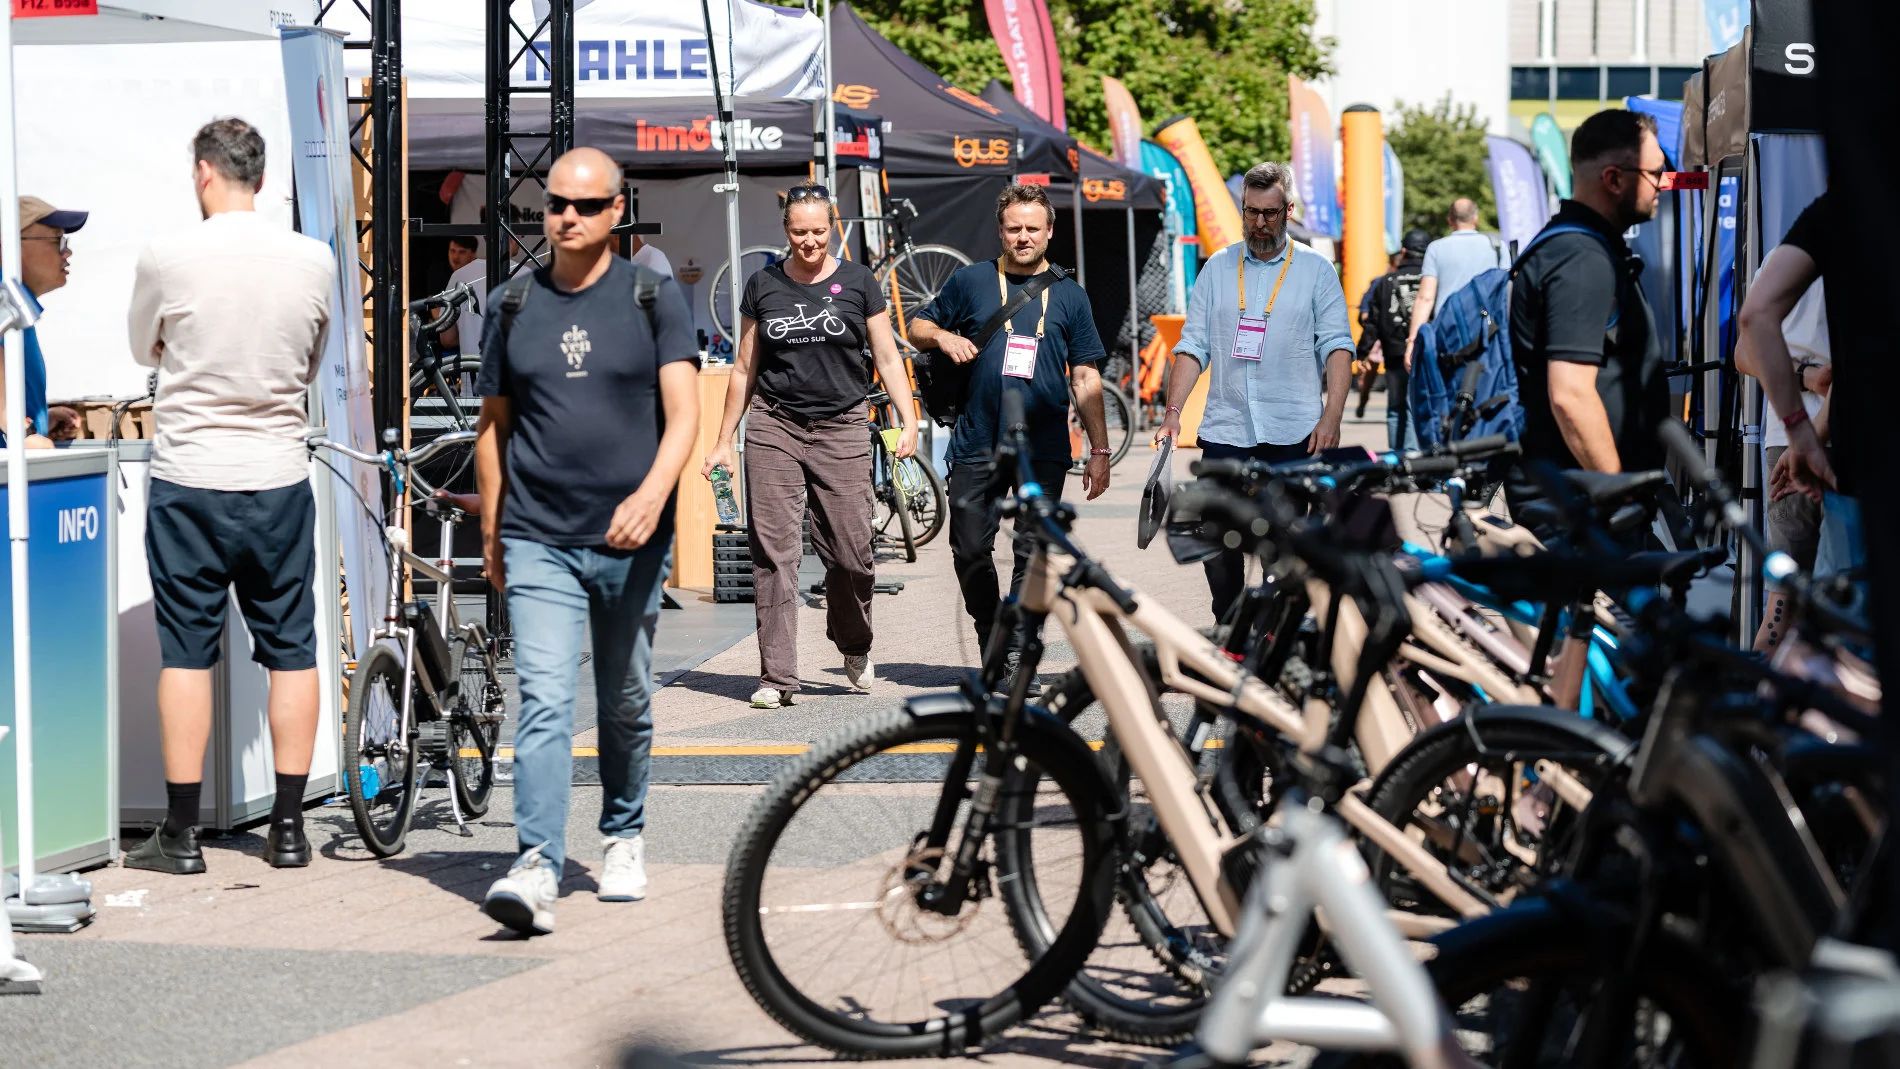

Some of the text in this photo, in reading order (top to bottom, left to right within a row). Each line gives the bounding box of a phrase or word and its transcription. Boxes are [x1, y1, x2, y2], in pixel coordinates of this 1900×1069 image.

[1784, 42, 1816, 75] S
[953, 134, 1010, 168] igus
[1082, 177, 1126, 202] igus
[58, 505, 99, 544] INFO
